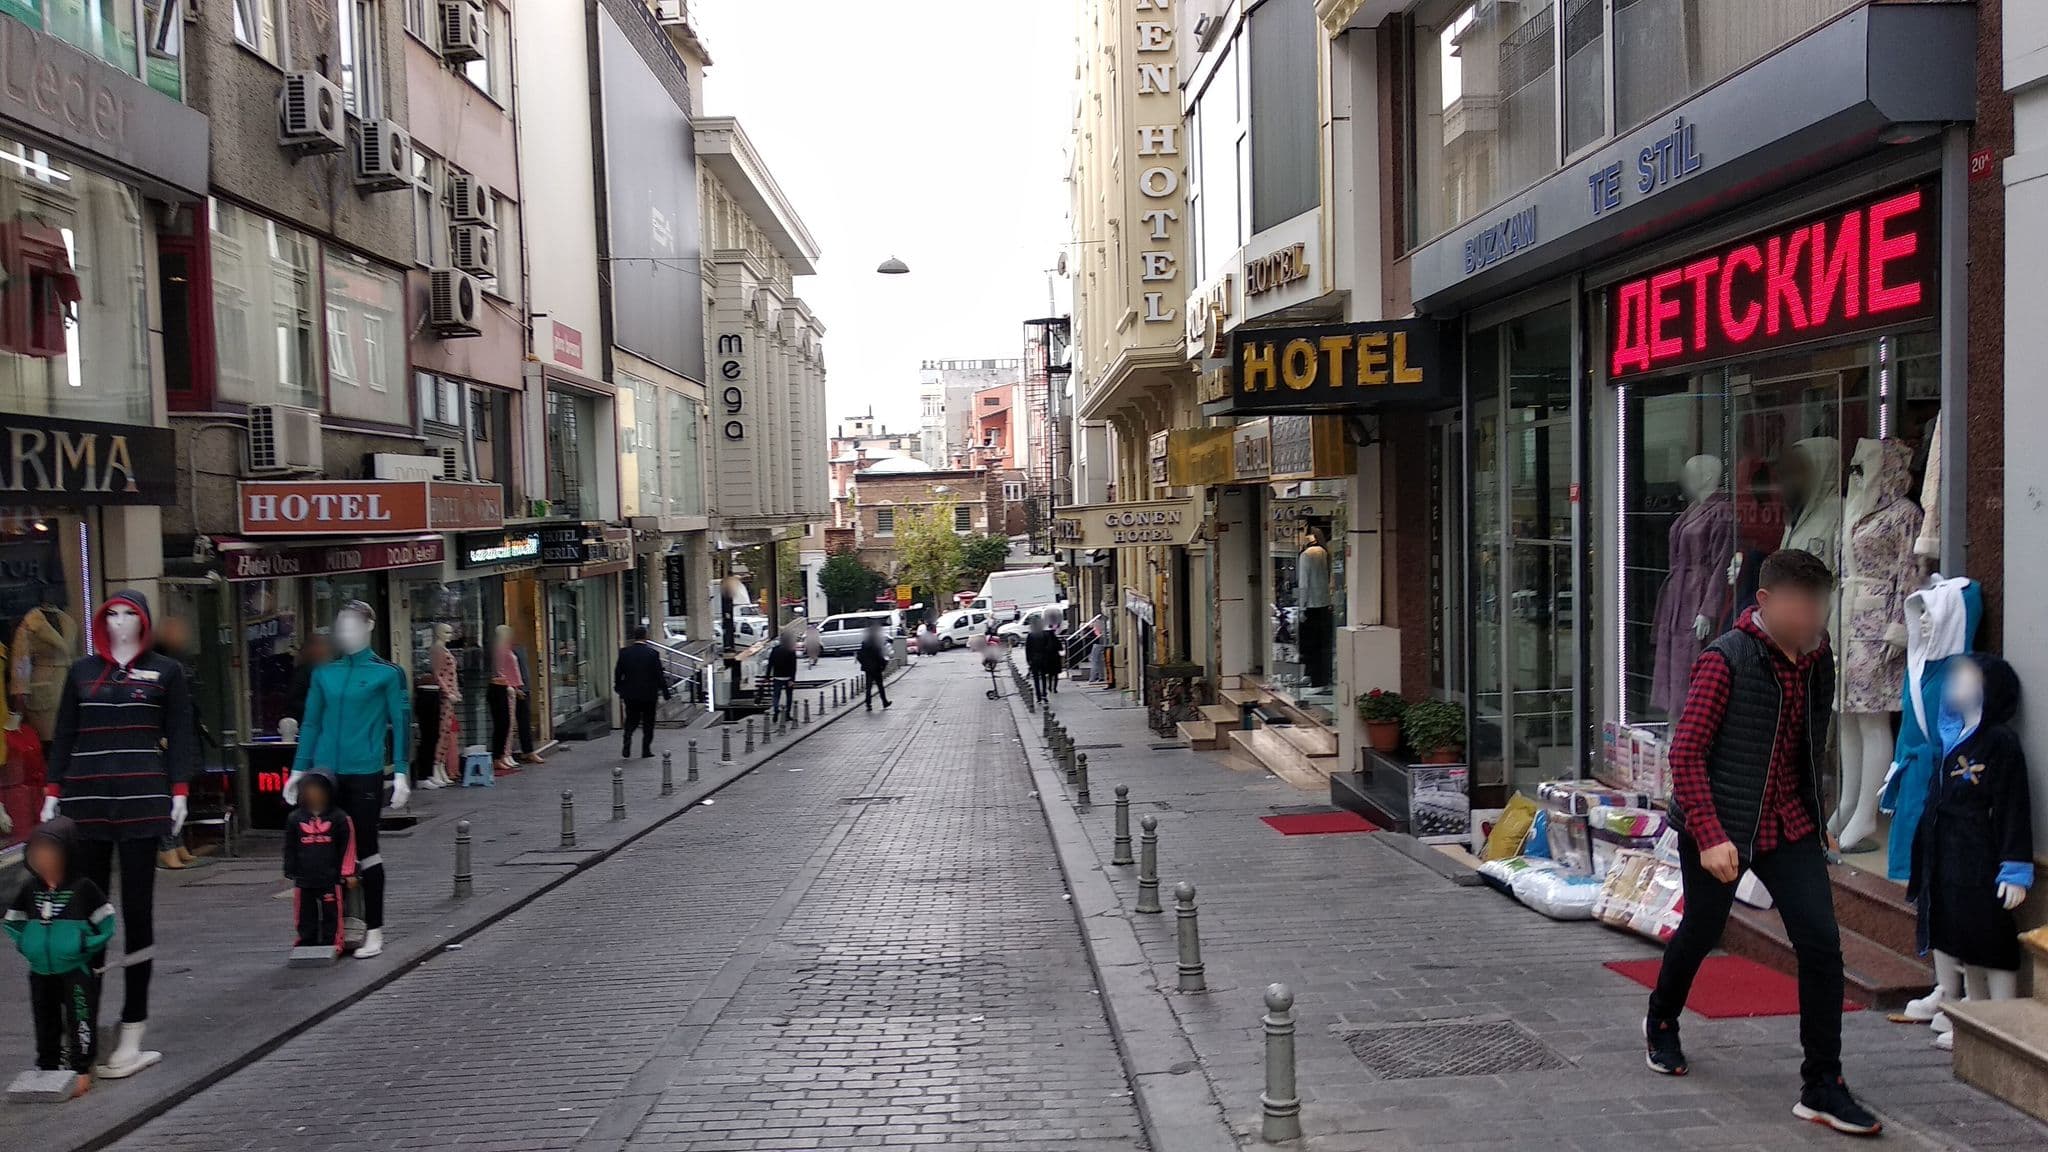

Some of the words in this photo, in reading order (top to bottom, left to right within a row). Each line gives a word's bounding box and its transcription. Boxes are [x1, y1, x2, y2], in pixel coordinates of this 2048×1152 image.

[1137, 124, 1179, 323] HOTEL
[1464, 205, 1536, 274] BUZKAN
[1588, 160, 1622, 215] TE
[1637, 116, 1702, 193] STİL
[1245, 242, 1310, 296] HOTEL
[1612, 190, 1922, 377] ДЕТСКИЕ
[719, 333, 744, 440] mega
[1242, 331, 1424, 393] HOTEL
[0, 426, 139, 493] RMA
[248, 494, 391, 521] HOTEL
[1105, 509, 1182, 527] GÖNEN
[1114, 528, 1173, 543] HOTEL
